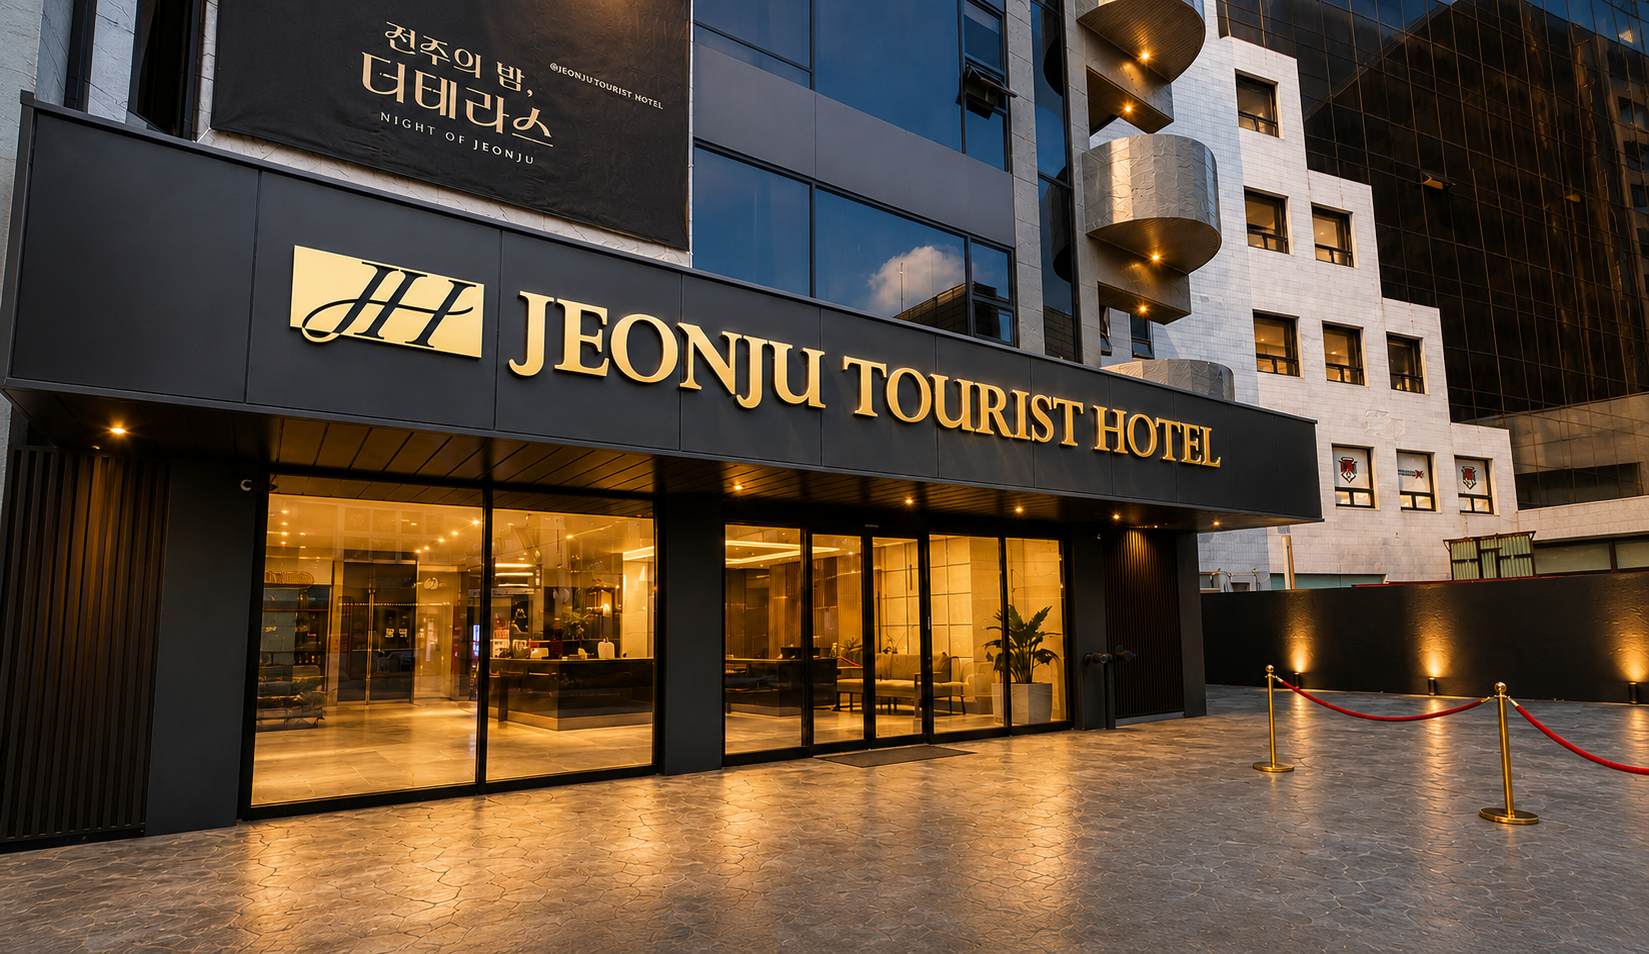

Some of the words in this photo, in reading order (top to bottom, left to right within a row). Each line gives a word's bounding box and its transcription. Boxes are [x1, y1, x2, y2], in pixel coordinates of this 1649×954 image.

[384, 21, 482, 79] 전주의
[496, 61, 533, 98] 밤,
[361, 51, 554, 148] 더테라스
[380, 111, 436, 135] NIGHT
[445, 131, 465, 144] OF
[473, 139, 534, 165] JEONJU
[634, 93, 664, 110] HOTEL
[508, 290, 827, 410] JEONJU
[841, 355, 1084, 448] TOURIST
[1092, 404, 1222, 469] HOTEL
